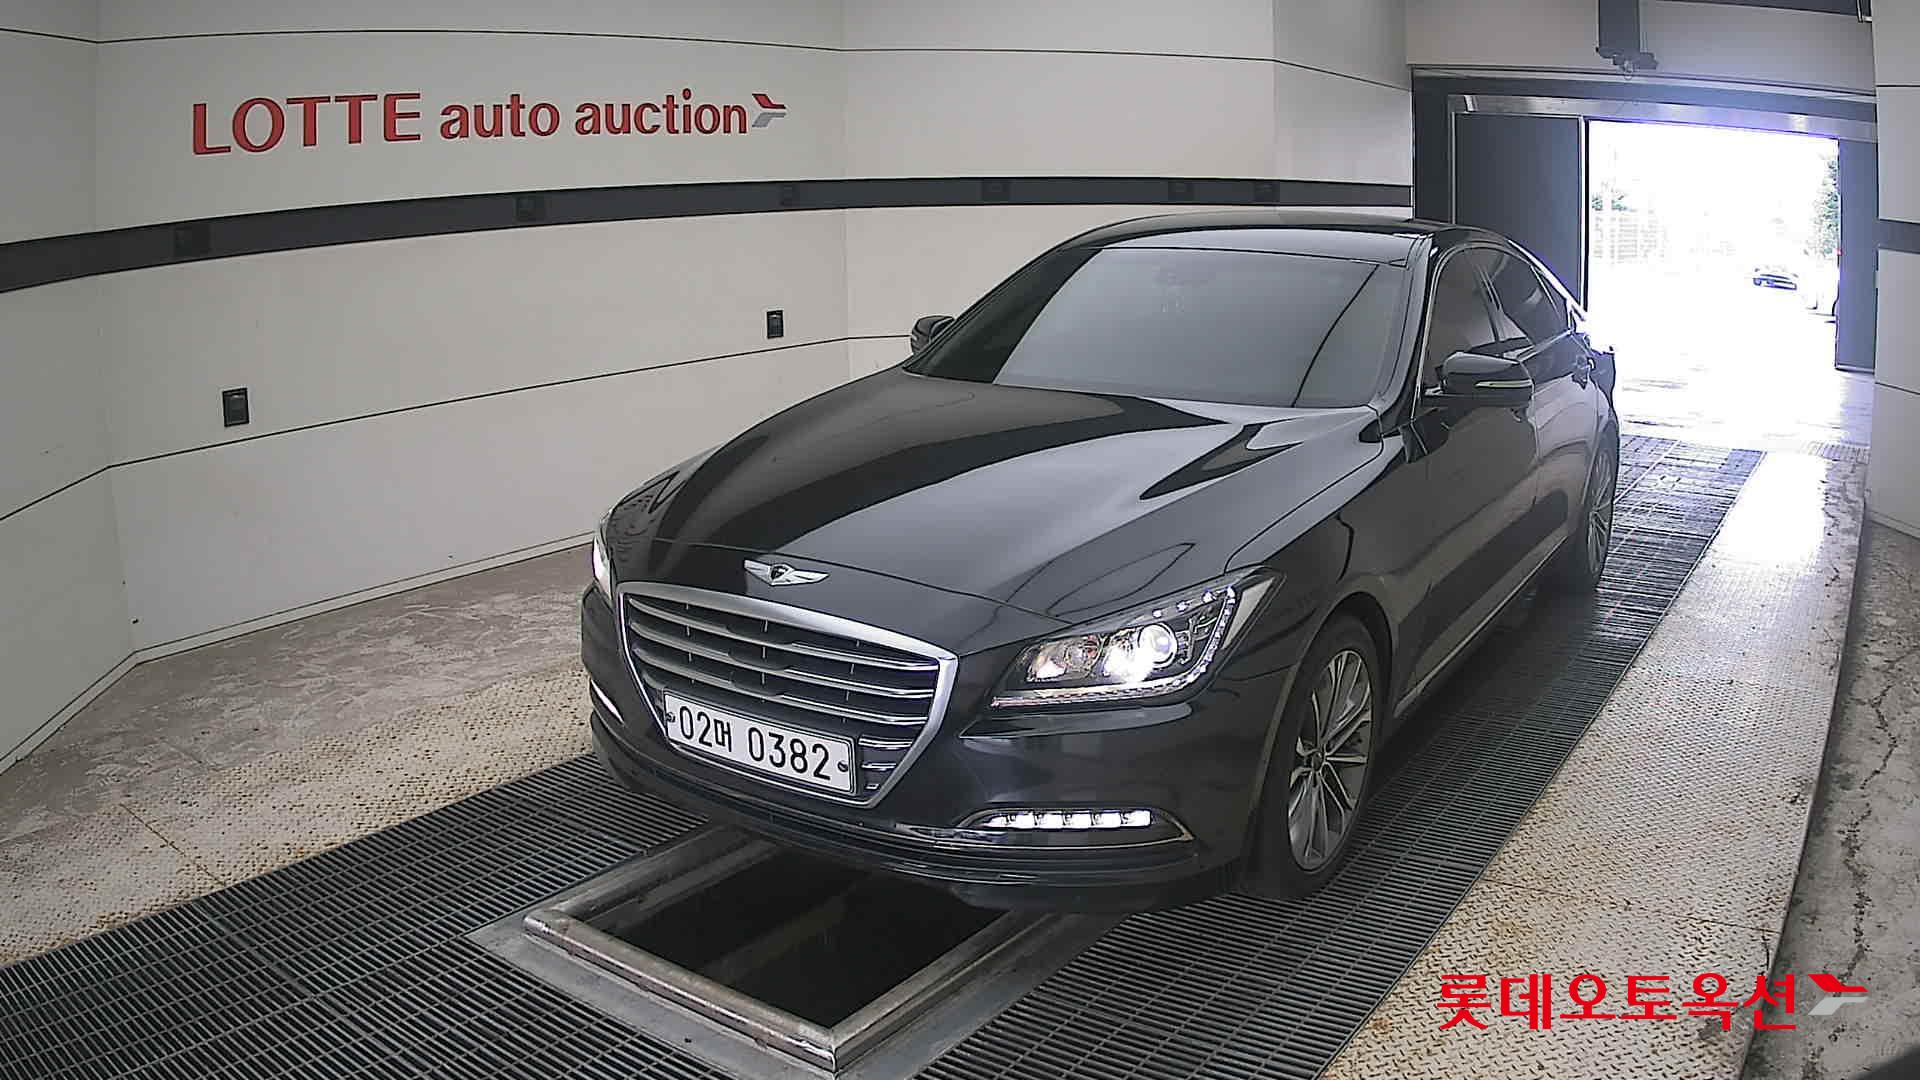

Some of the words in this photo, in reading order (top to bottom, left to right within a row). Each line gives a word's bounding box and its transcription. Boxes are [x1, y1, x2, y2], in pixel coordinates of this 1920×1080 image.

[191, 93, 421, 155] LOTTE
[440, 94, 560, 140] auto
[575, 87, 748, 135] auction
[679, 706, 733, 753] 02머
[748, 727, 831, 781] 0382
